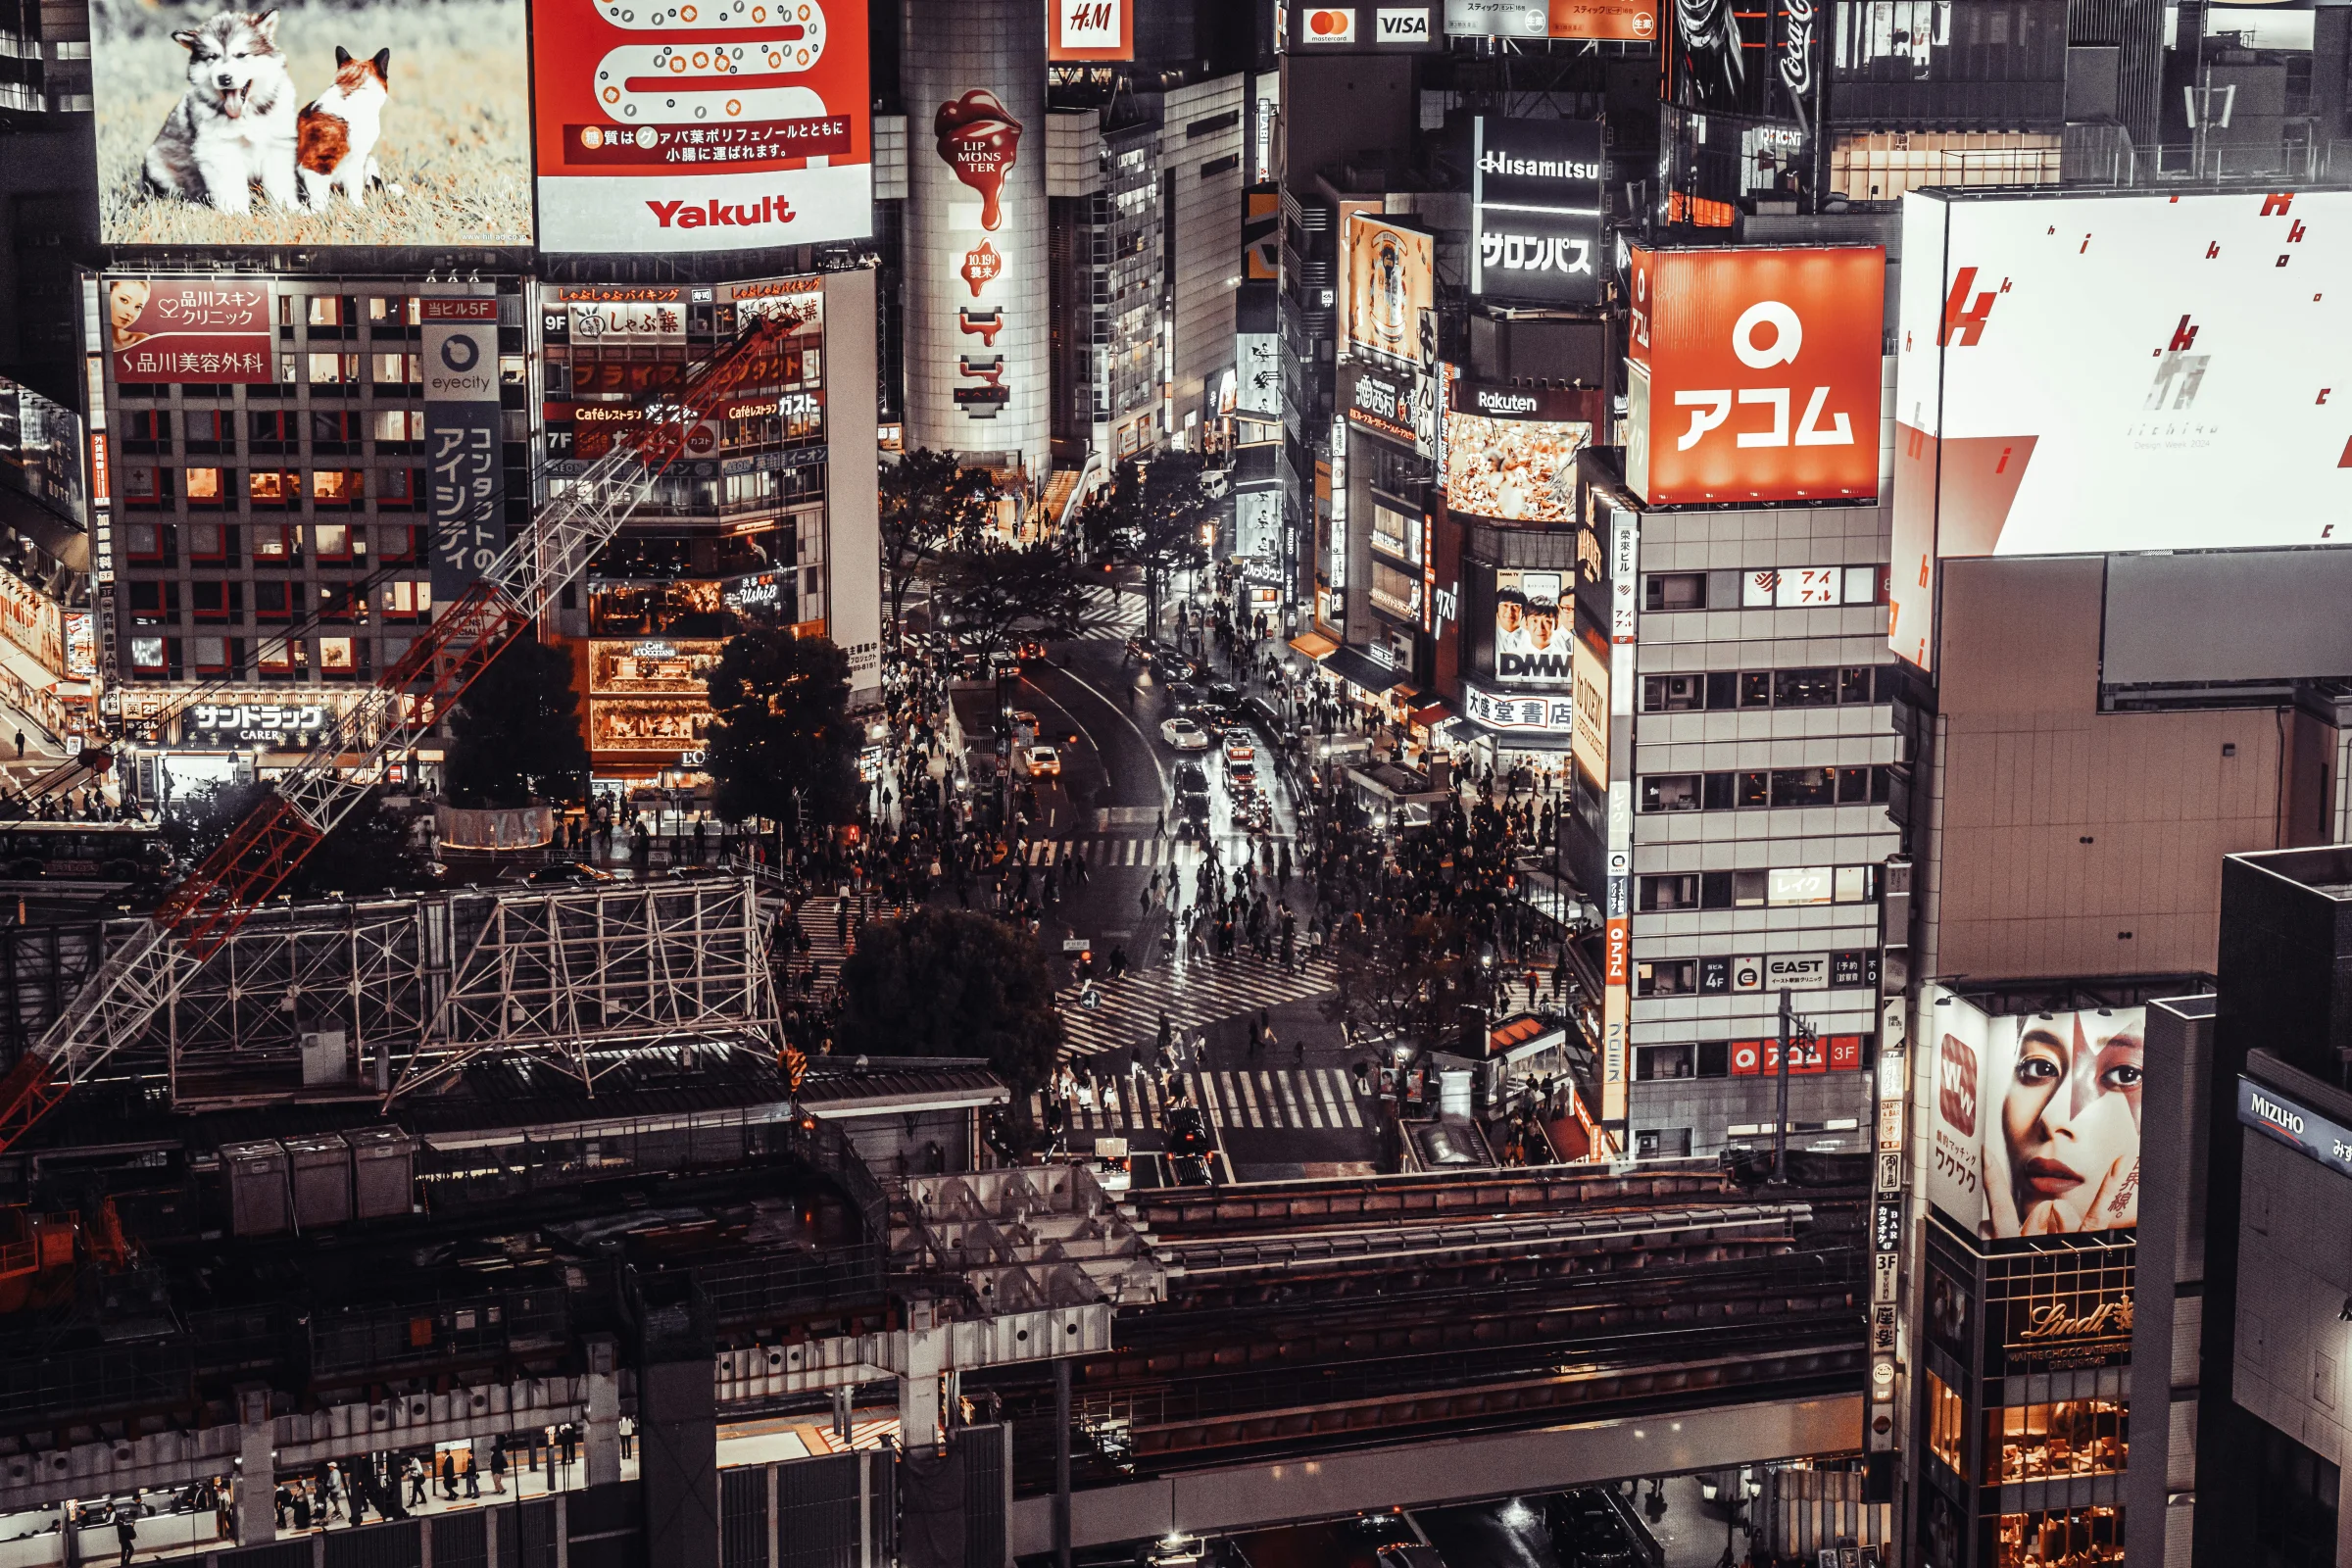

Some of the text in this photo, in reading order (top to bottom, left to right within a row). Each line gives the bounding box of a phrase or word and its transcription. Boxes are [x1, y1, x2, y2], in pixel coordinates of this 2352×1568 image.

[1070, 3, 1112, 32] H&M
[1379, 17, 1427, 33] VISA
[584, 122, 844, 147] 糖質はグァバ葉ポリフェノールとともに
[1259, 115, 1269, 142] LABI
[665, 143, 787, 162] 小腸に運ばれます。
[964, 142, 986, 151] LIP
[968, 164, 996, 172] TER
[1477, 150, 1599, 180] Hisamitsu
[646, 195, 796, 228] Yakult
[967, 255, 991, 266] 10.19
[1481, 231, 1592, 275] サロンパス
[181, 291, 262, 308] 品川スキン
[559, 287, 680, 302] しゃぶしゃぶバイキング
[181, 310, 253, 326] クリニック
[427, 302, 488, 317] 当ビル5F
[545, 316, 566, 330] 9F
[610, 311, 679, 334] しゃぶ葉
[136, 352, 265, 374] 品川美容外科
[432, 376, 490, 393] eyecity
[778, 393, 818, 416] ガスト
[1478, 391, 1538, 412] Rakuten
[1674, 387, 1854, 450] アコム
[548, 432, 573, 449] 7F
[433, 427, 469, 570] アイシティ
[470, 428, 497, 570] コンタクトの
[196, 706, 322, 729] サンドラッグ
[1470, 692, 1572, 724] 大盛堂書店
[1777, 874, 1821, 893] レイク
[1609, 944, 1622, 976] アコム
[1771, 960, 1824, 973] EAST
[1705, 972, 1724, 988] 4F
[1608, 1022, 1624, 1083] プロミス
[1834, 1046, 1855, 1060] 3F
[1881, 1102, 1901, 1110] DARTS
[1888, 1109, 1900, 1118] BAR
[2251, 1093, 2305, 1135] MIZUHO
[1936, 1146, 1977, 1194] ワクワク
[1878, 1206, 1887, 1244] カラオケ
[1889, 1210, 1898, 1240] BAR
[1882, 1242, 1892, 1250] 4F
[1878, 1255, 1896, 1269] 3F
[2021, 1302, 2115, 1338] Lindt
